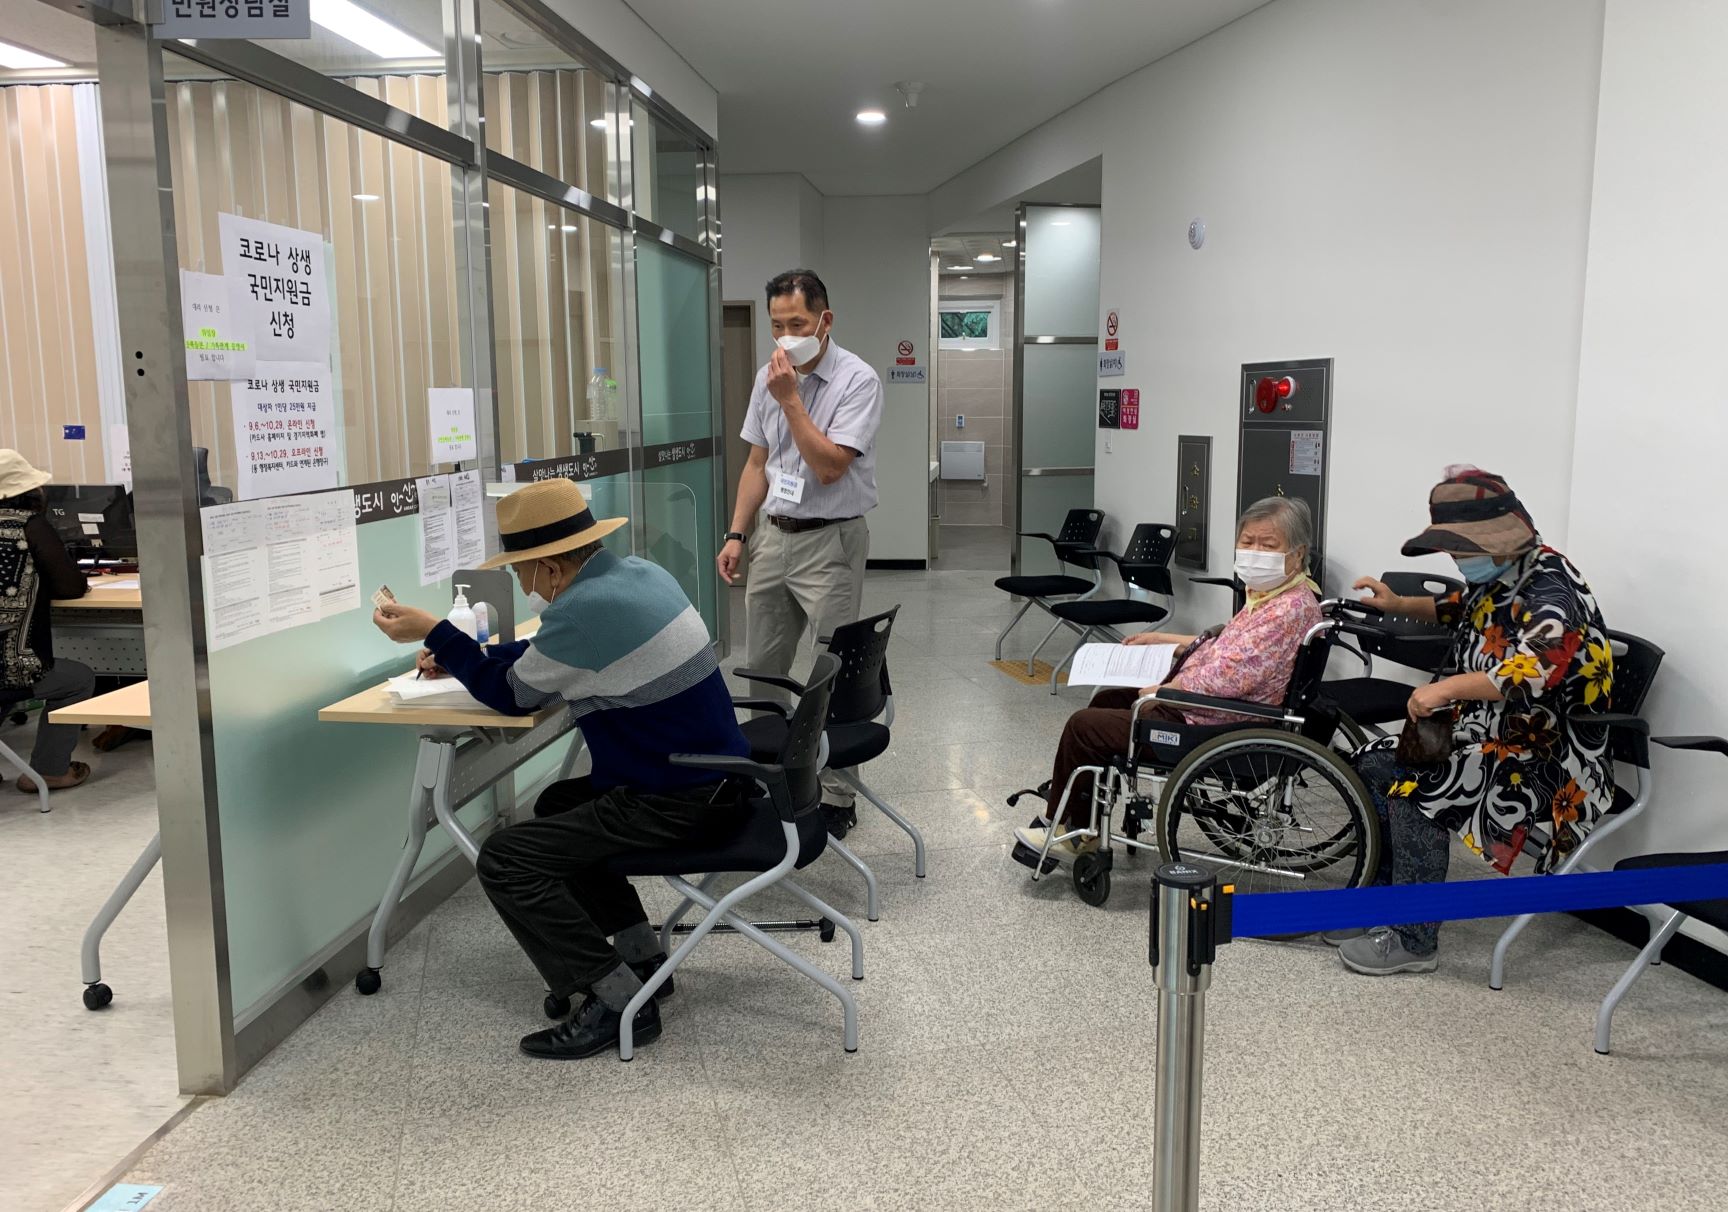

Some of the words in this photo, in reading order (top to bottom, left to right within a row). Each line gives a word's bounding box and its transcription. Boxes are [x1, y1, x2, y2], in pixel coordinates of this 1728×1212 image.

[240, 238, 280, 266] 코로나
[288, 247, 312, 276] 상생
[248, 273, 312, 306] 국민지원금
[270, 311, 295, 339] 신청
[247, 379, 268, 391] 코로나
[271, 379, 285, 393] 상생
[288, 379, 320, 393] 국민지원금
[257, 403, 273, 413] 대상자
[275, 402, 287, 413] 1인당
[289, 402, 305, 412] 25만원
[307, 402, 316, 412] 지급
[287, 419, 303, 430] 온라인
[305, 419, 315, 430] 신청
[267, 432, 285, 442] 홈페이지
[291, 447, 311, 458] 오프라인
[314, 446, 323, 457] 신청
[556, 460, 580, 480] 생생도시
[391, 482, 416, 513] 안산
[53, 508, 65, 516] TG
